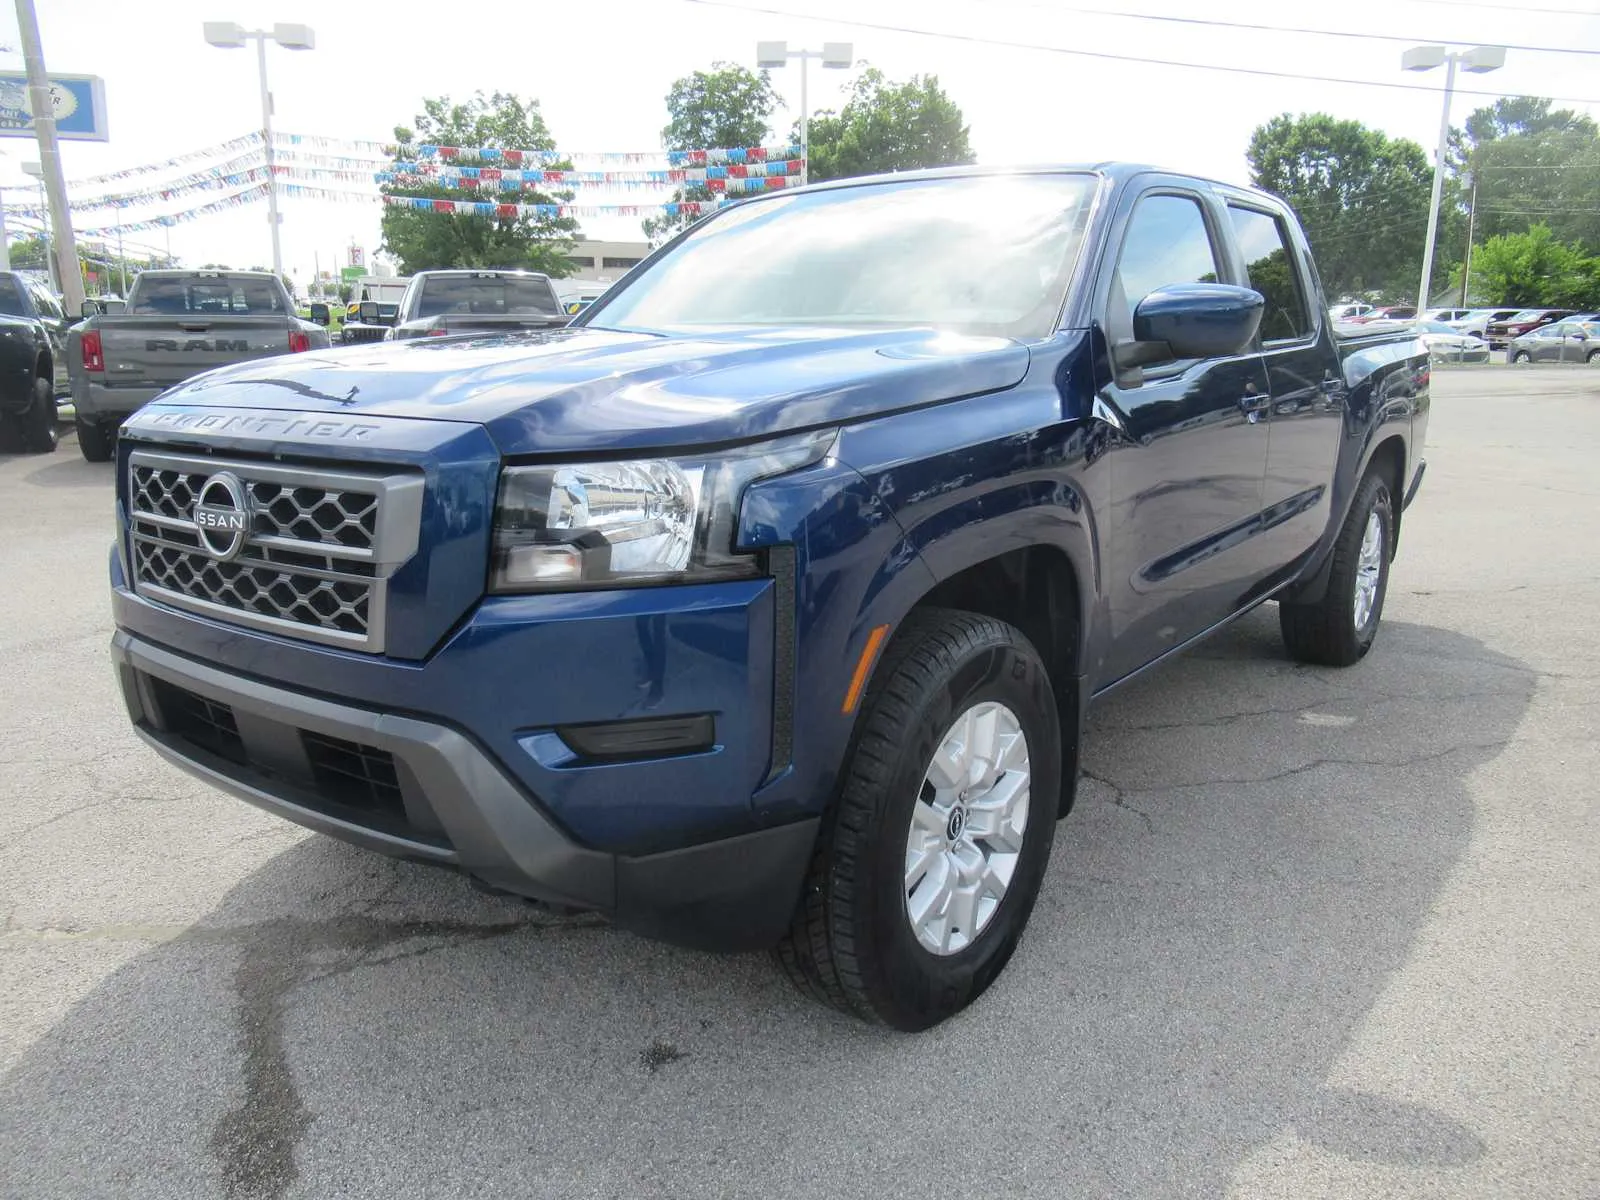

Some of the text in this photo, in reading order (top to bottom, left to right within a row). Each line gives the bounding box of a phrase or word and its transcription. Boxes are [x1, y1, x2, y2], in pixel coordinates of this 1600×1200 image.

[146, 339, 249, 352] RAM
[153, 412, 381, 439] FRONTIER
[194, 510, 243, 529] ISSAN
